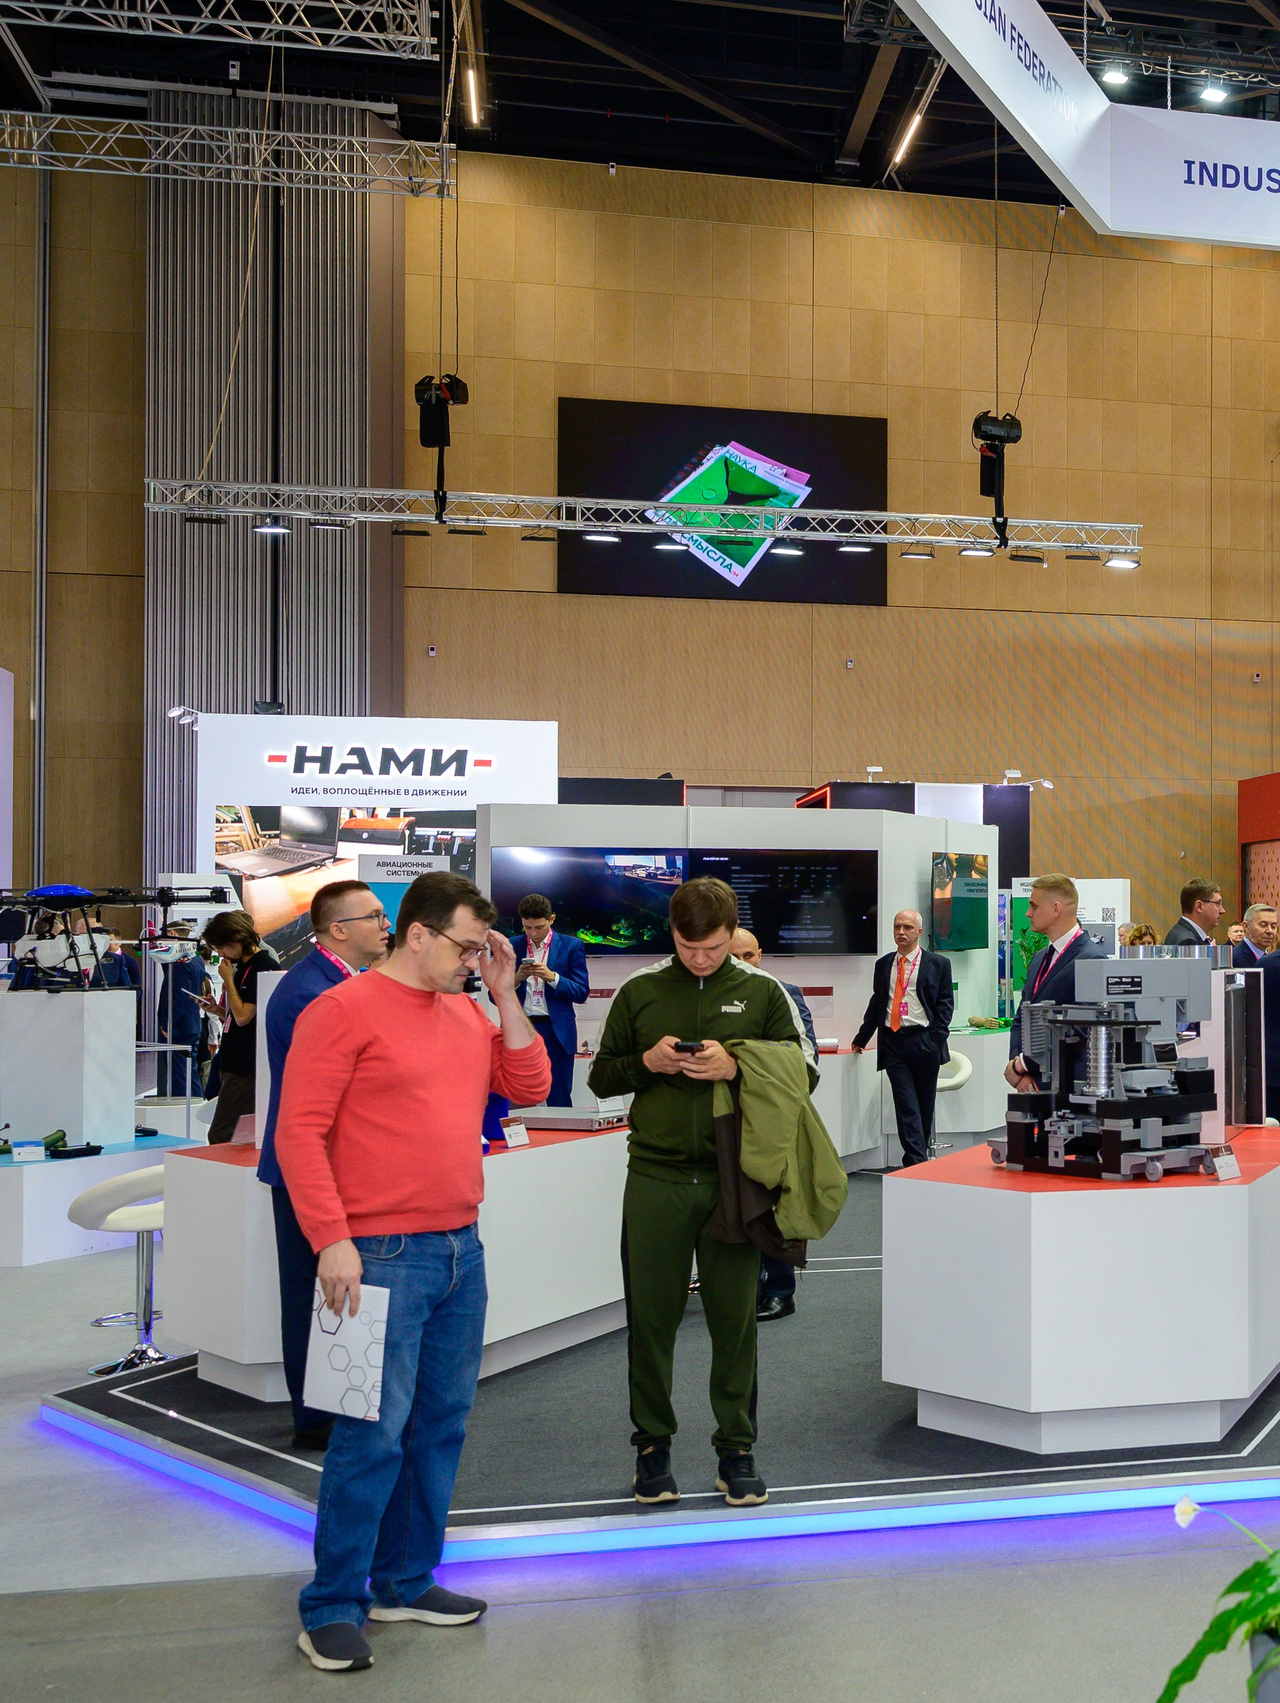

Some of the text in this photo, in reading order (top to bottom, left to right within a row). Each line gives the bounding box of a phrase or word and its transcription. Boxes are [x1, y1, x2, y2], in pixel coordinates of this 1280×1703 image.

[724, 449, 758, 474] НАУКА
[681, 532, 733, 573] СМЫСЛА
[293, 745, 468, 777] НАМИ
[290, 785, 468, 797] ИДЕИ, ВОПЛОЩЁННЫЕ В ДВИЖЕНИИ
[376, 860, 434, 869] АВИАЦИОННЫЕ
[386, 869, 424, 877] СИСТЕМЫ
[721, 1005, 742, 1013] PUMA
